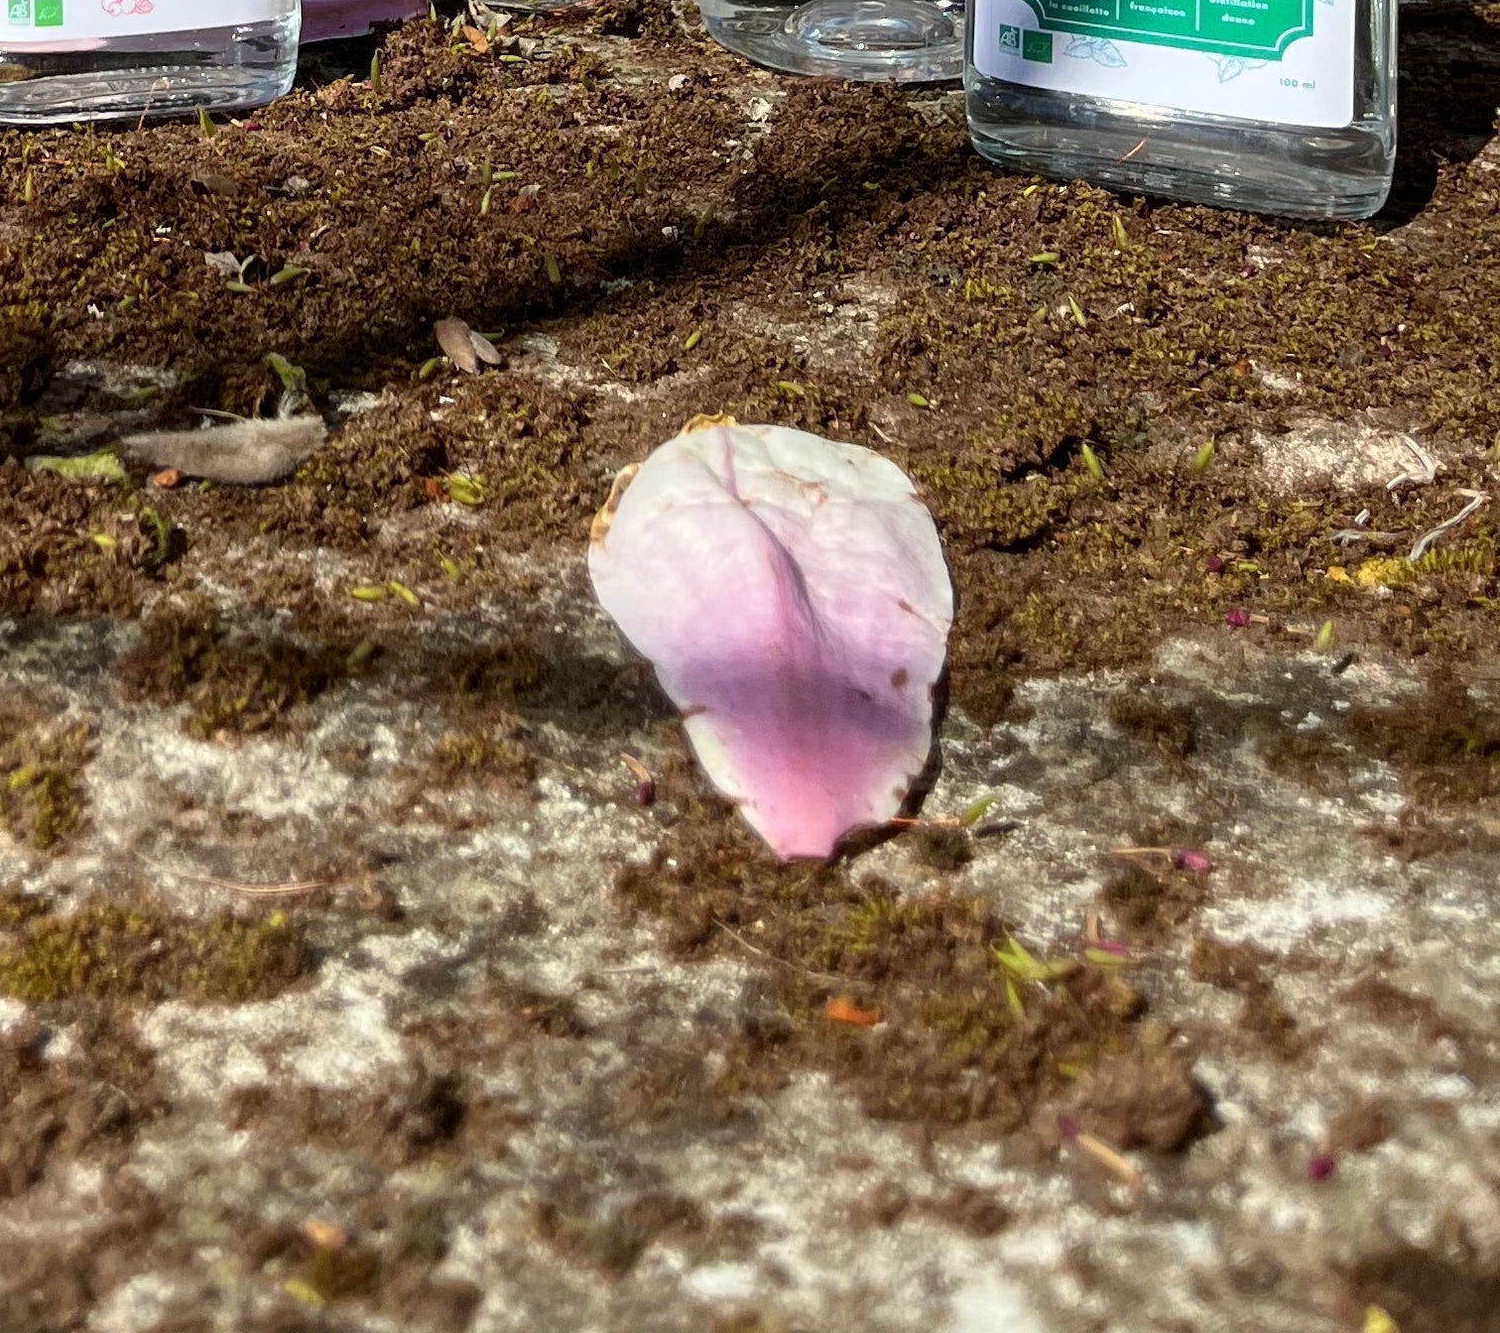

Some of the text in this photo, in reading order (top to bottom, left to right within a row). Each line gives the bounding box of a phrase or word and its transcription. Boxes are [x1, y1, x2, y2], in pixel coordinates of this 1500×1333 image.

[1049, 0, 1110, 16] la cueillette
[1130, 1, 1186, 18] françaises
[1280, 78, 1316, 89] 100 ml
